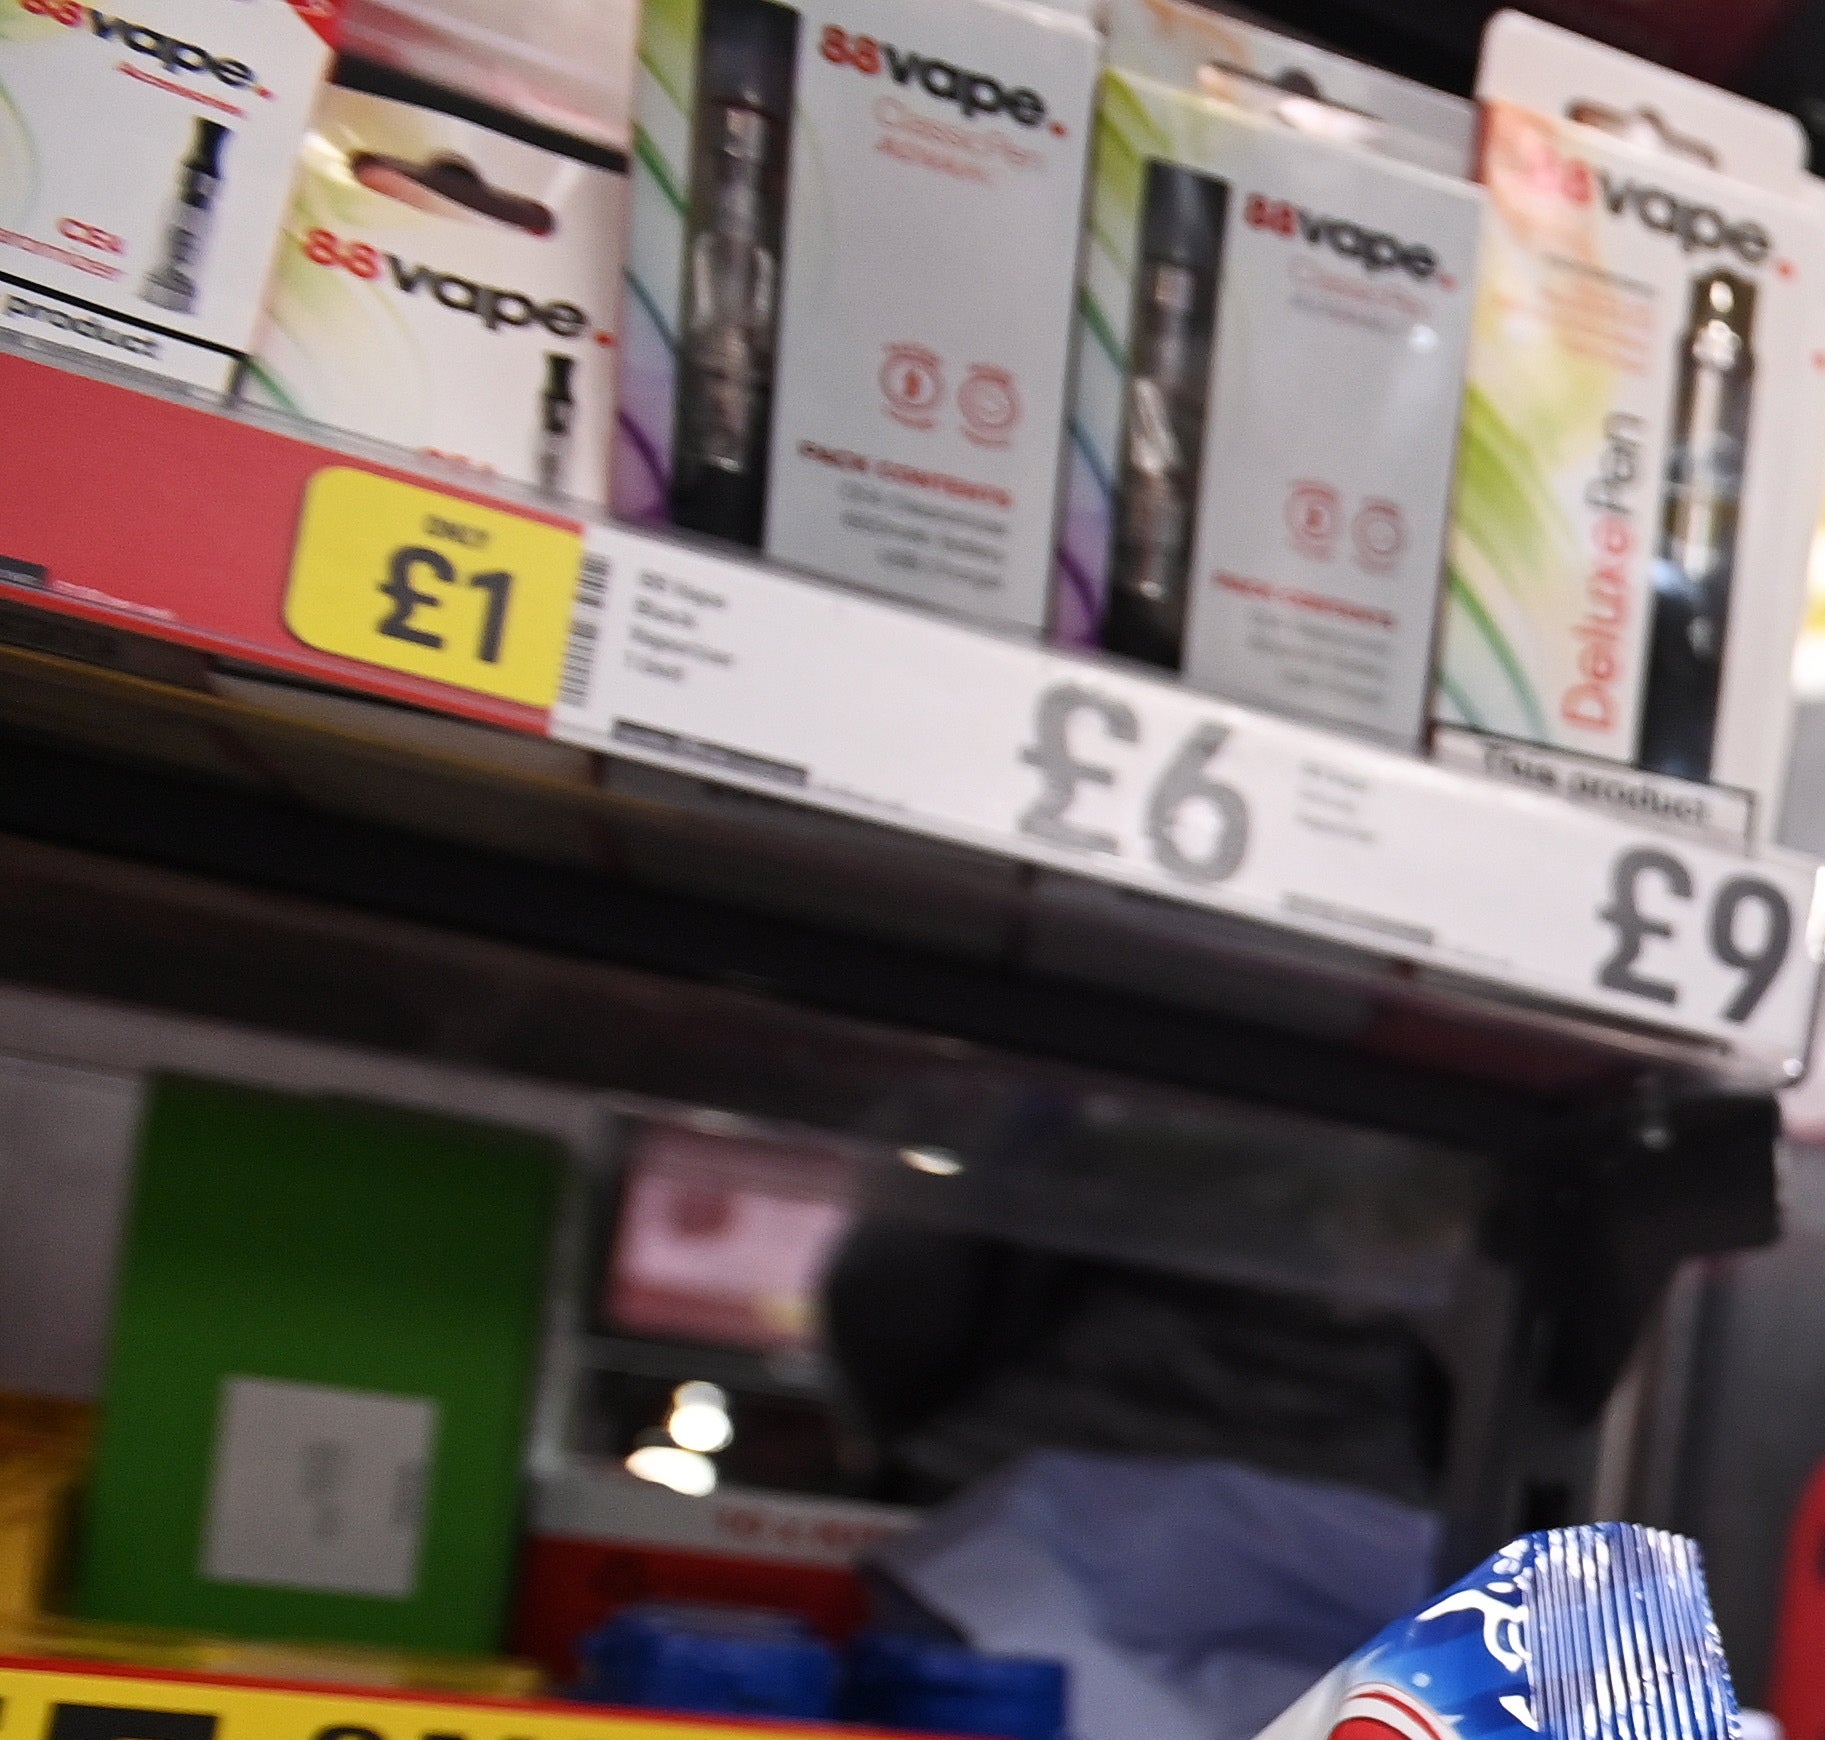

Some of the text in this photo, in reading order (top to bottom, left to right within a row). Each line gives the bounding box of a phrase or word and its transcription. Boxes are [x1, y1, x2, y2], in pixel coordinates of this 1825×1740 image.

[4, 295, 163, 361] product
[374, 544, 514, 665] £1
[1015, 680, 1253, 886] £6
[1591, 844, 1796, 1026] £9
